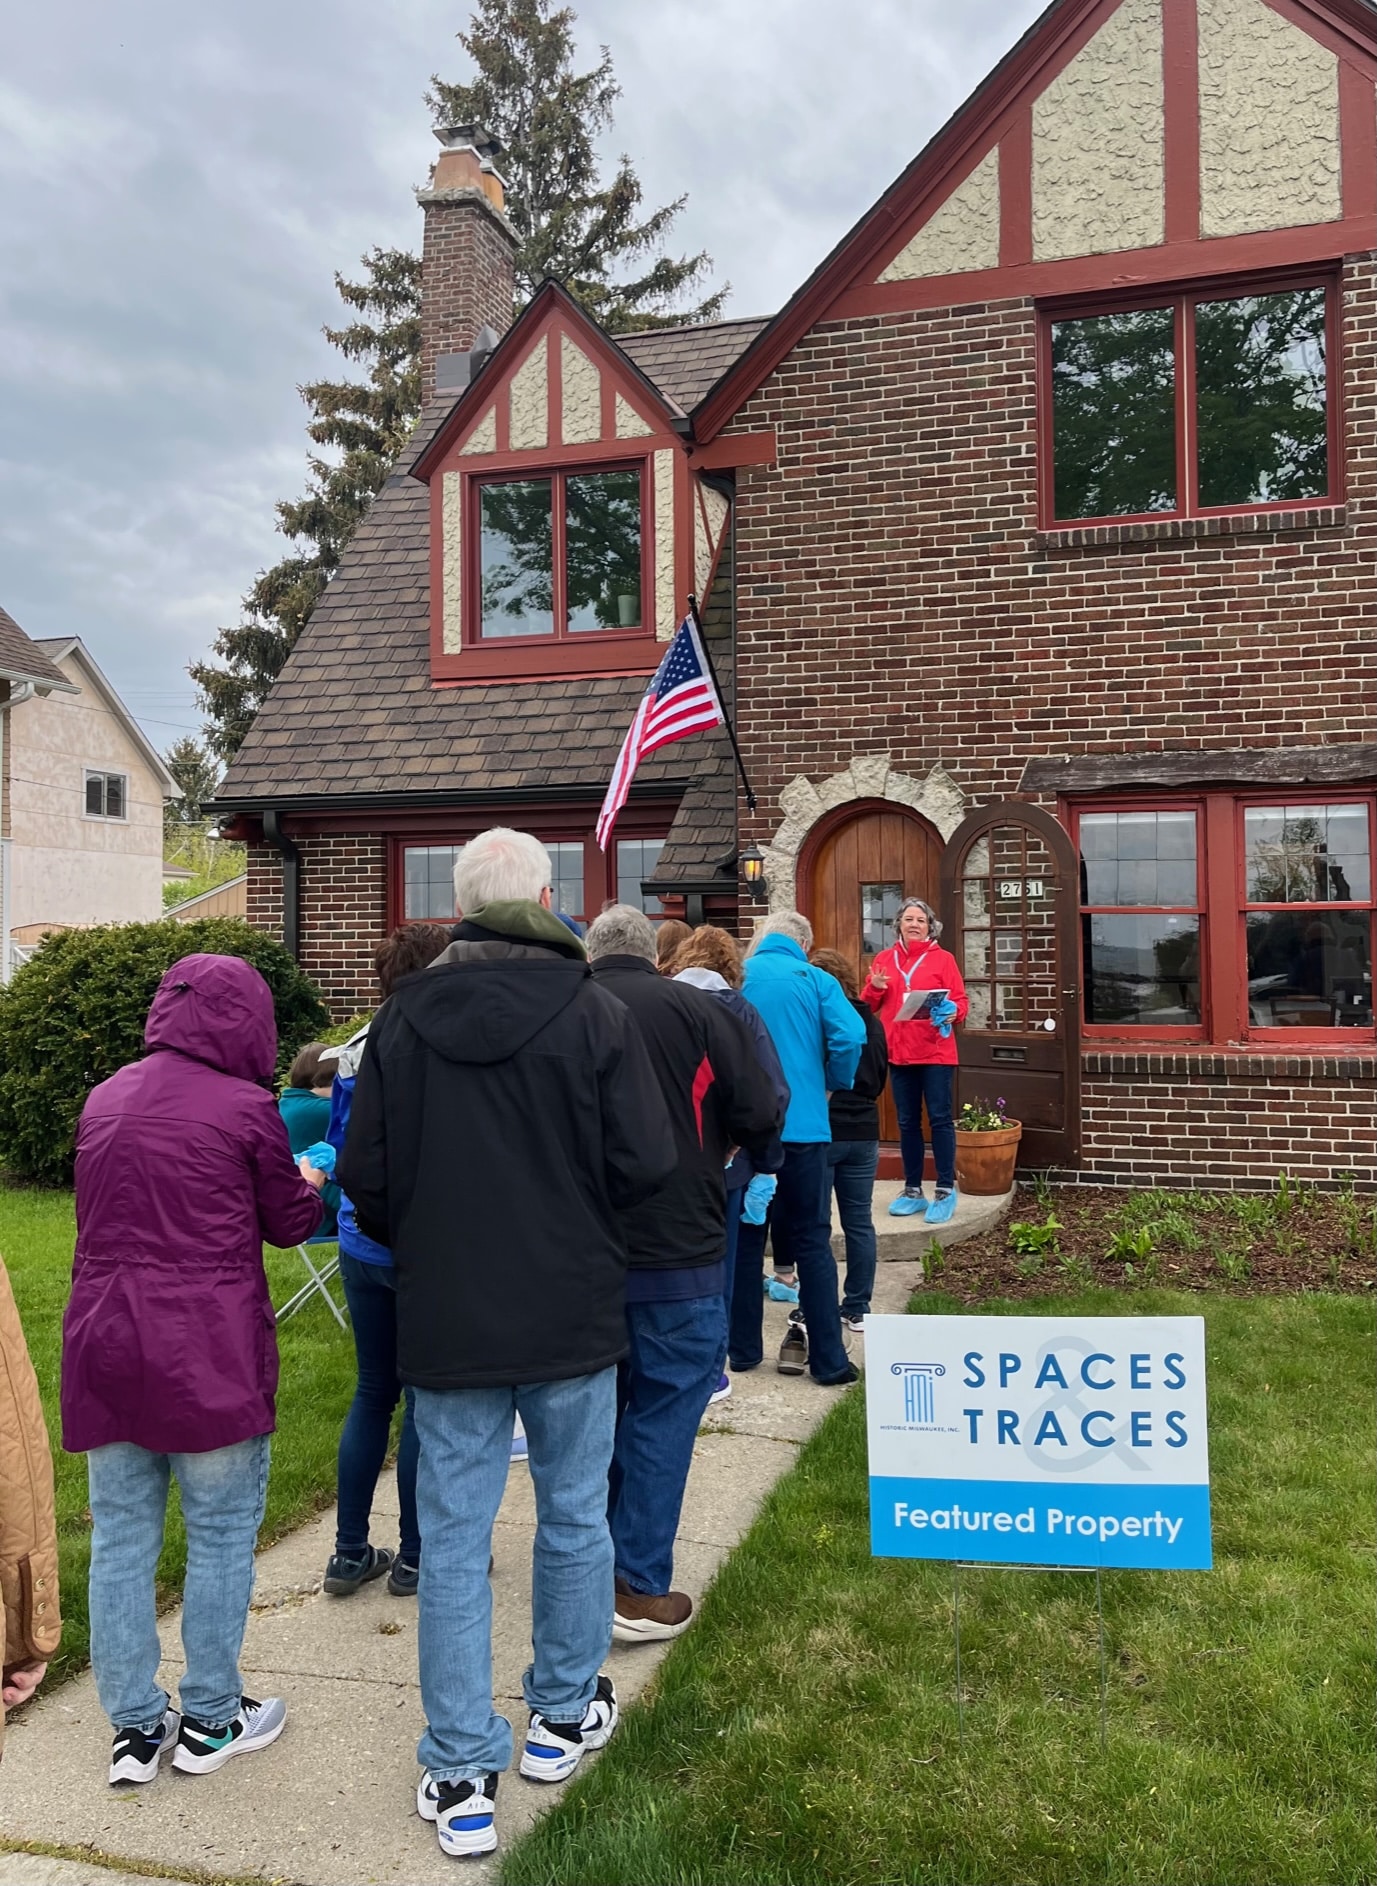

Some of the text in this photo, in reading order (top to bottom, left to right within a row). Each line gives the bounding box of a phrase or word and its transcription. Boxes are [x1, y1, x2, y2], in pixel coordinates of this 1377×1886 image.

[963, 1351, 1187, 1390] SPACES
[963, 1408, 1188, 1448] TRACES
[894, 1502, 1184, 1544] Featured Property
